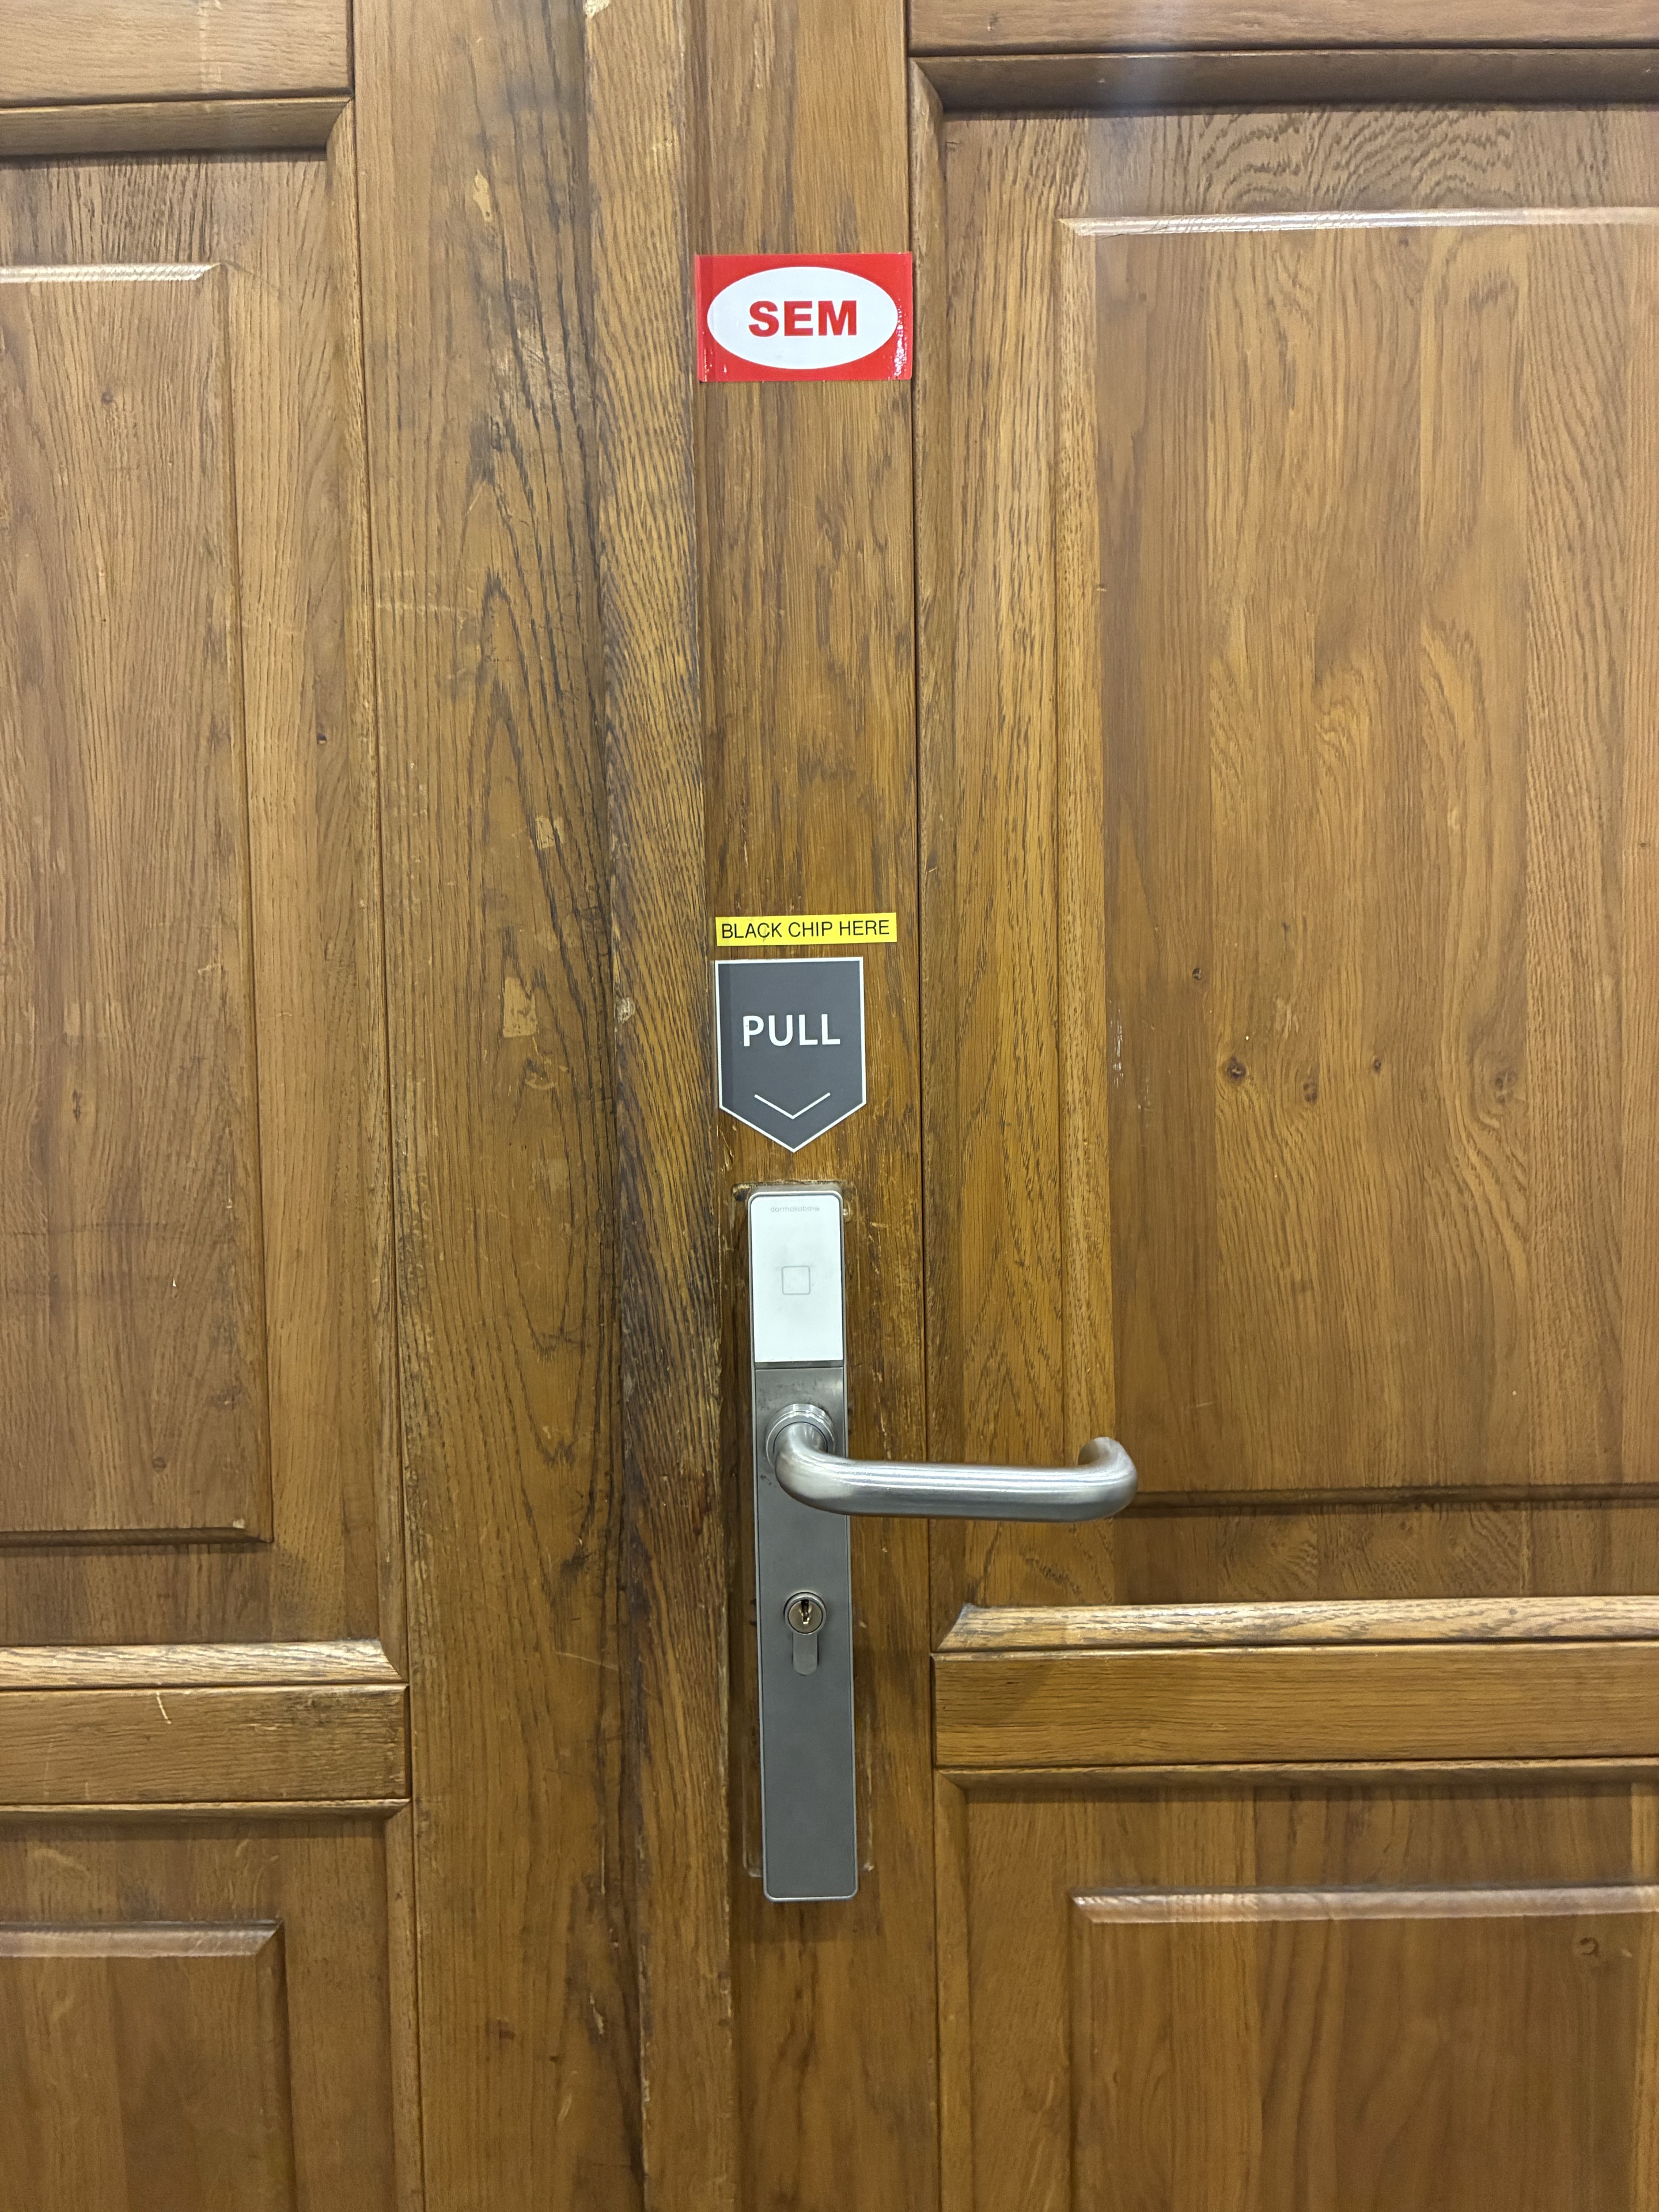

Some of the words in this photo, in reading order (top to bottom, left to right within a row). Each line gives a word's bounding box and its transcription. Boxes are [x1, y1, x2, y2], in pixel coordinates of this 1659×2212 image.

[748, 300, 857, 337] SEM
[721, 922, 782, 938] BLACK
[788, 921, 832, 937] CHIP
[839, 920, 889, 935] HERE
[743, 1014, 840, 1047] PULL
